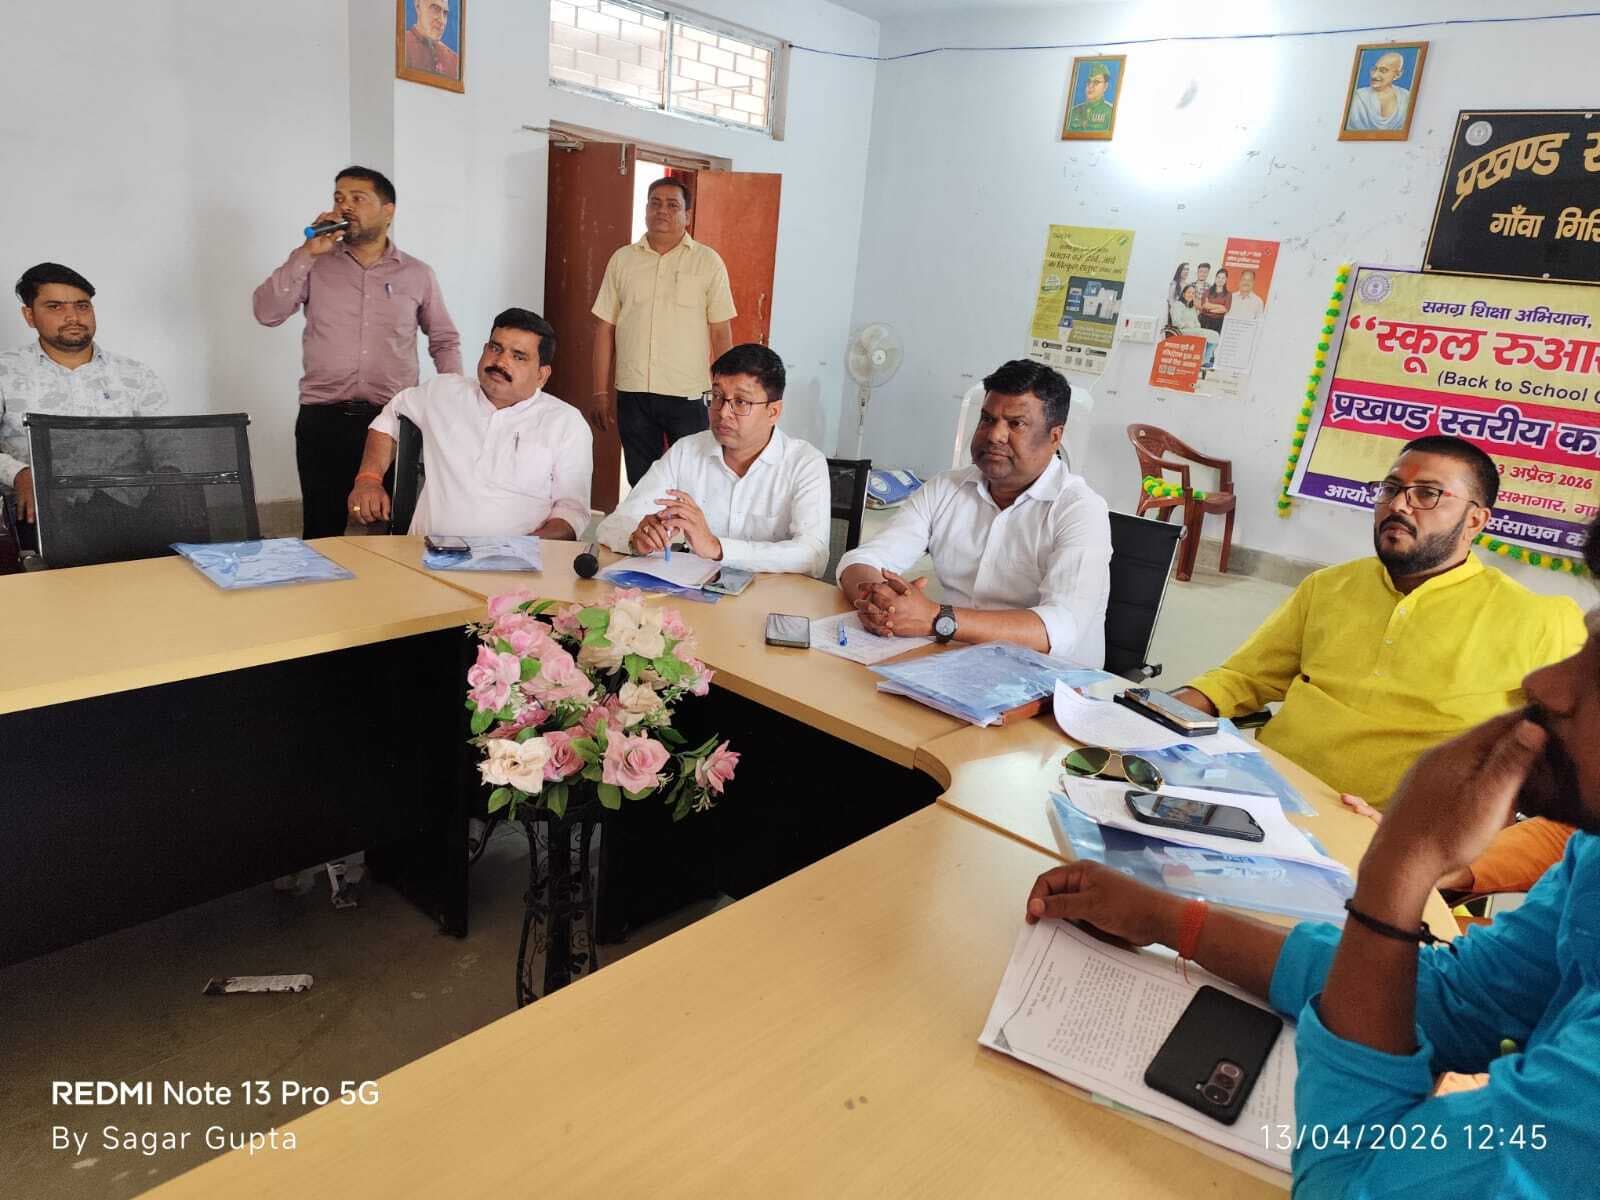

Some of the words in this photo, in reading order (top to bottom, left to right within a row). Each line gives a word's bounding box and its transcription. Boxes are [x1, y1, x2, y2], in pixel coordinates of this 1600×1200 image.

[1422, 301, 1466, 317] समग्र
[1471, 301, 1512, 320] शिक्षा
[1515, 306, 1592, 328] अभियान,
[1493, 331, 1600, 374] रुआ
[1437, 370, 1488, 390] (Back
[1495, 377, 1513, 392] to
[1519, 380, 1588, 403] School
[1333, 393, 1433, 427] प्रखण्ड
[1440, 407, 1552, 446] स्तरीय
[1558, 473, 1593, 490] 2026
